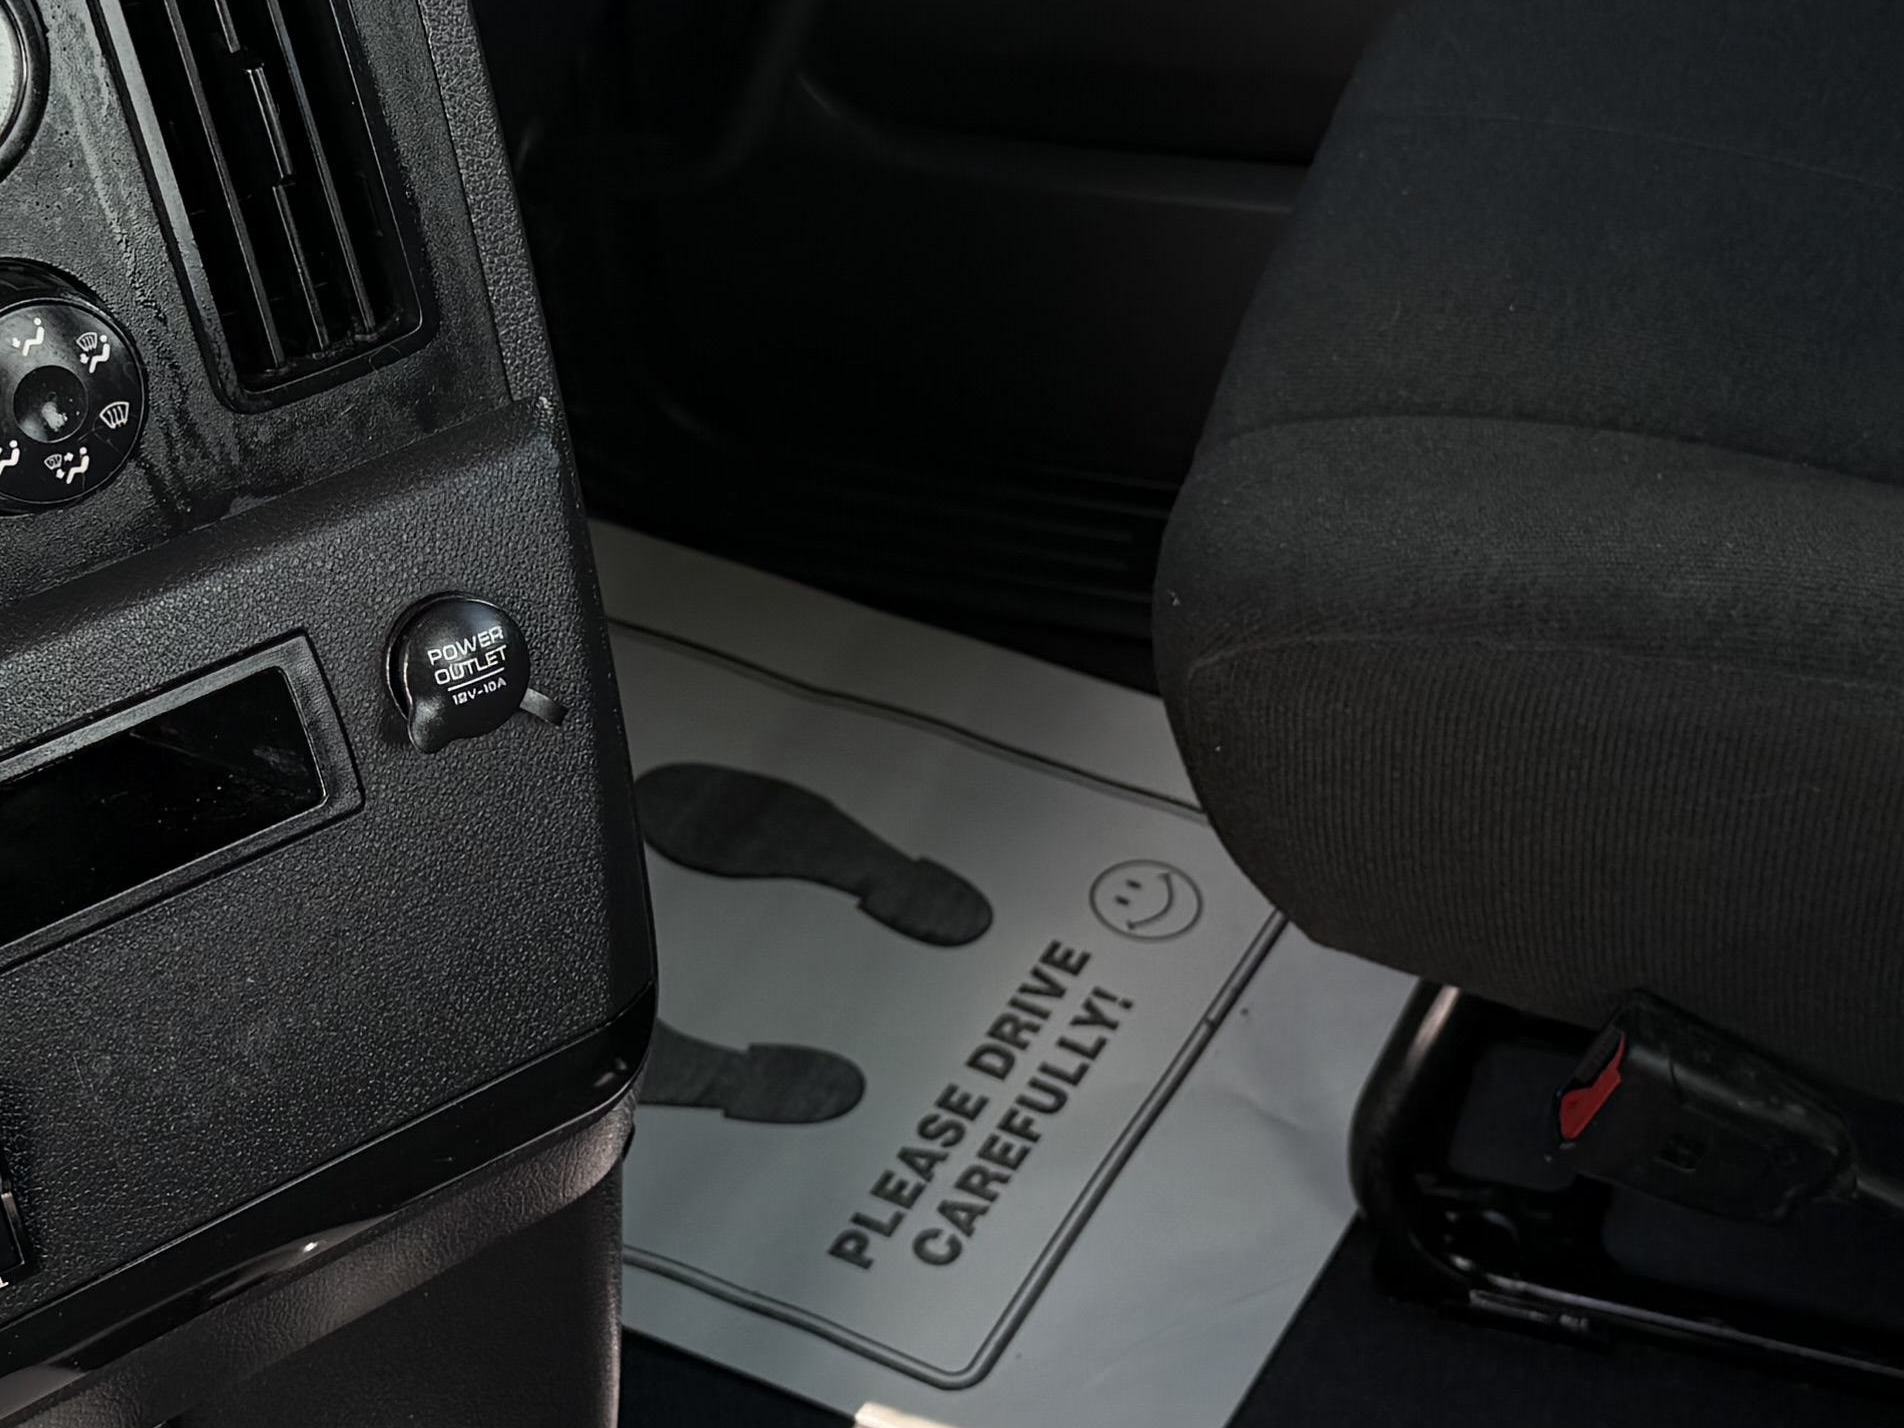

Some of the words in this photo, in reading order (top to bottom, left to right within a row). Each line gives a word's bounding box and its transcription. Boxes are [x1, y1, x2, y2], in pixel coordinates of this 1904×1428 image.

[427, 625, 504, 666] POWER
[434, 644, 507, 686] OUTLET
[827, 1082, 988, 1271] PLEASE
[967, 937, 1093, 1086] DRIVE
[911, 987, 1136, 1268] CAREFULLY!
